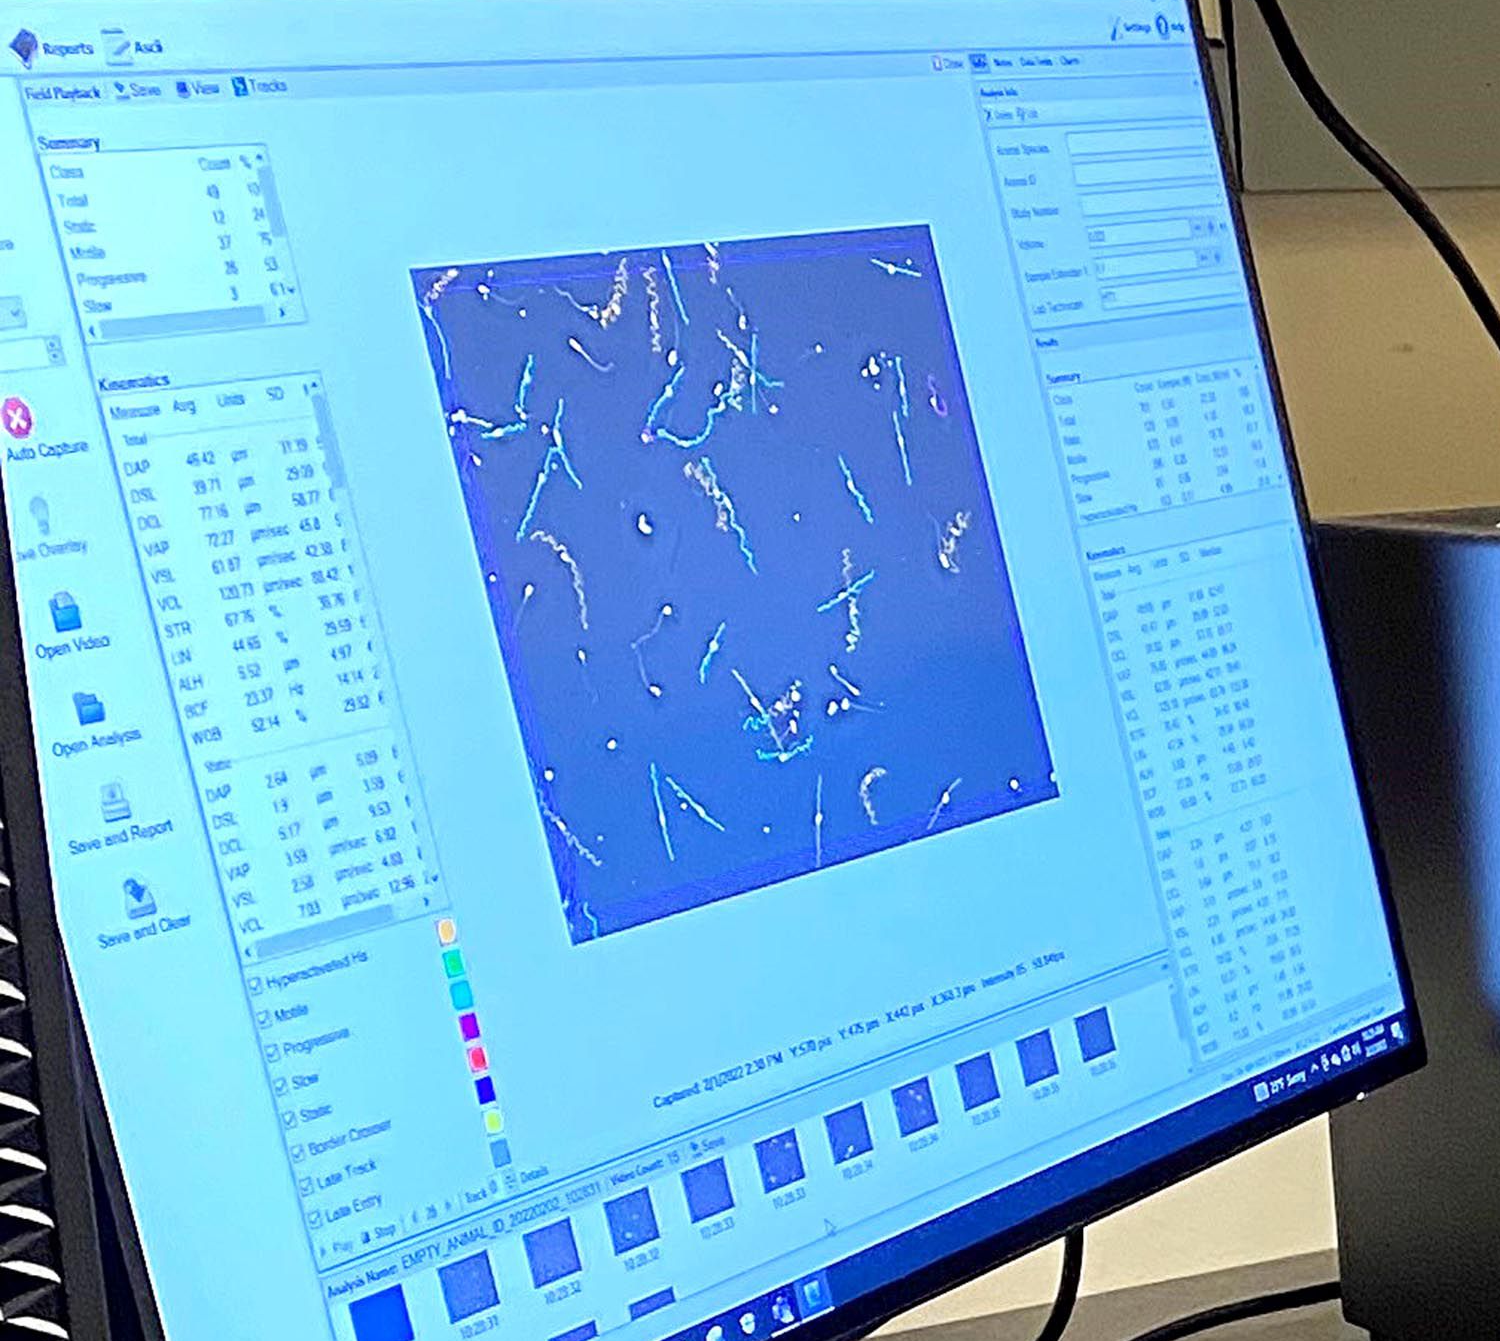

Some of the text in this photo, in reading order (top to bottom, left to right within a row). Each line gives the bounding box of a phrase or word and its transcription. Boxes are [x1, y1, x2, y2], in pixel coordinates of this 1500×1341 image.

[98, 375, 170, 391] Kinematics
[7, 446, 36, 462] Auto
[35, 634, 111, 662] Open Video
[52, 741, 89, 759] Open
[68, 819, 173, 855] Save and Report
[98, 932, 131, 949] Save
[134, 922, 157, 939] and
